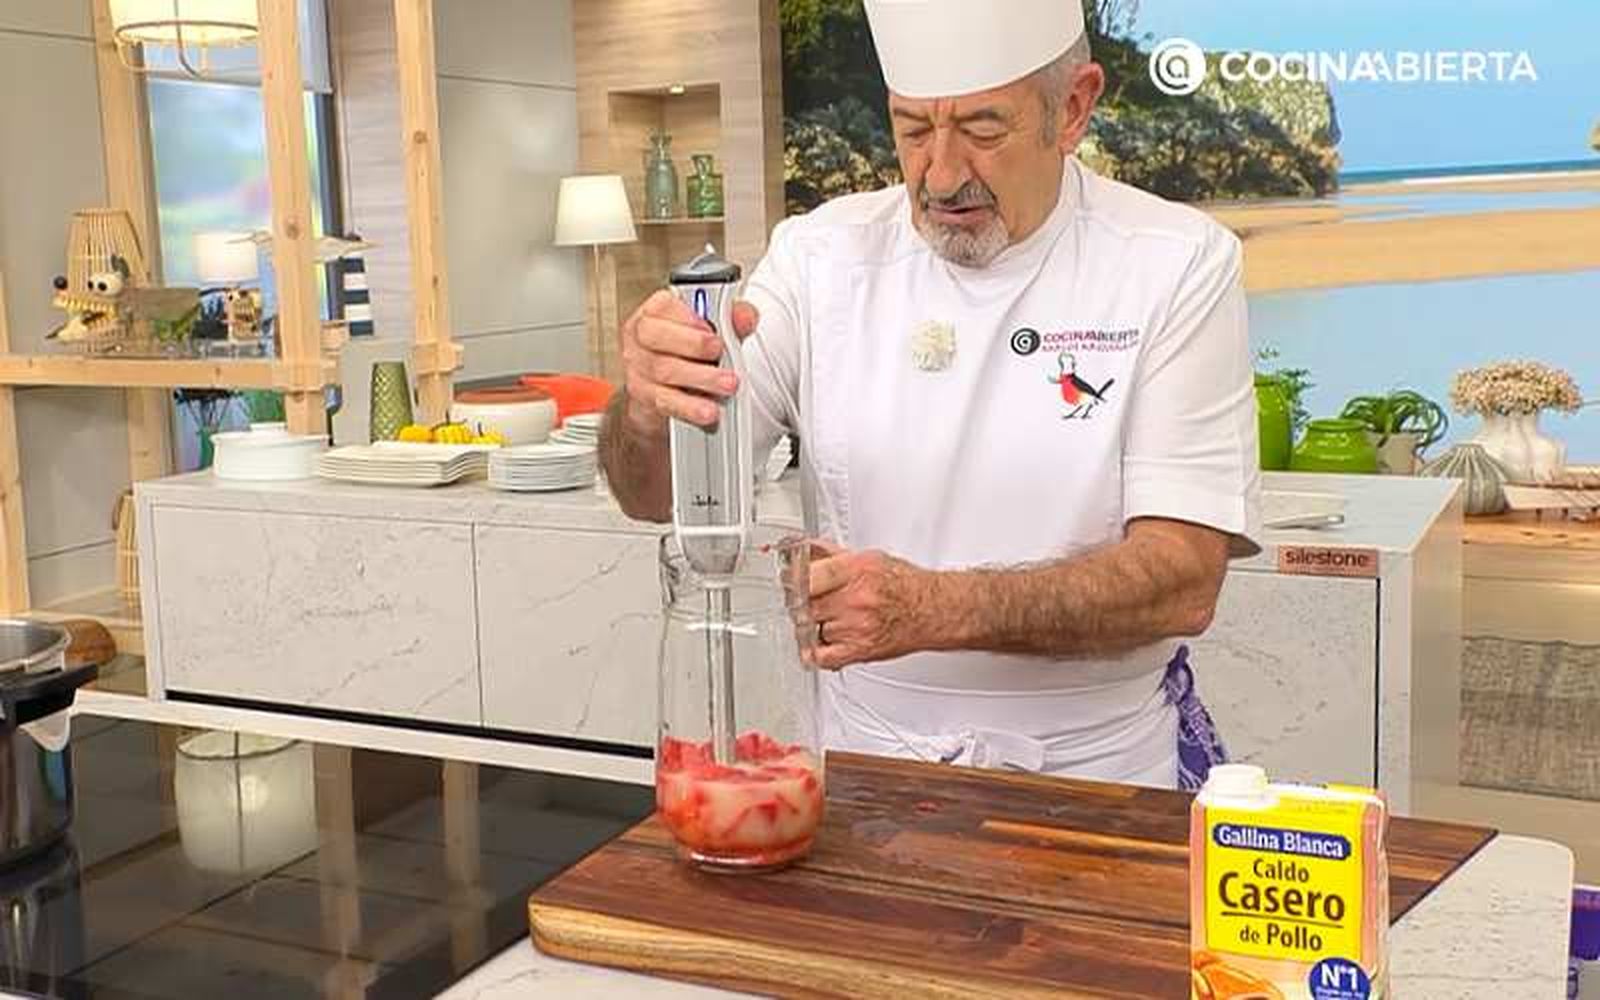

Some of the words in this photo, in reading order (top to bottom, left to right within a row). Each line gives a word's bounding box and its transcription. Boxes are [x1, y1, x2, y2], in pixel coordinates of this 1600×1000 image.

[1285, 547, 1369, 568] silestone
[1218, 825, 1280, 850] Gallina
[1283, 832, 1344, 858] Blanca
[1253, 858, 1310, 883] Caldo
[1218, 871, 1345, 921] Casero
[1239, 925, 1260, 944] de
[1266, 923, 1322, 951] Pollo
